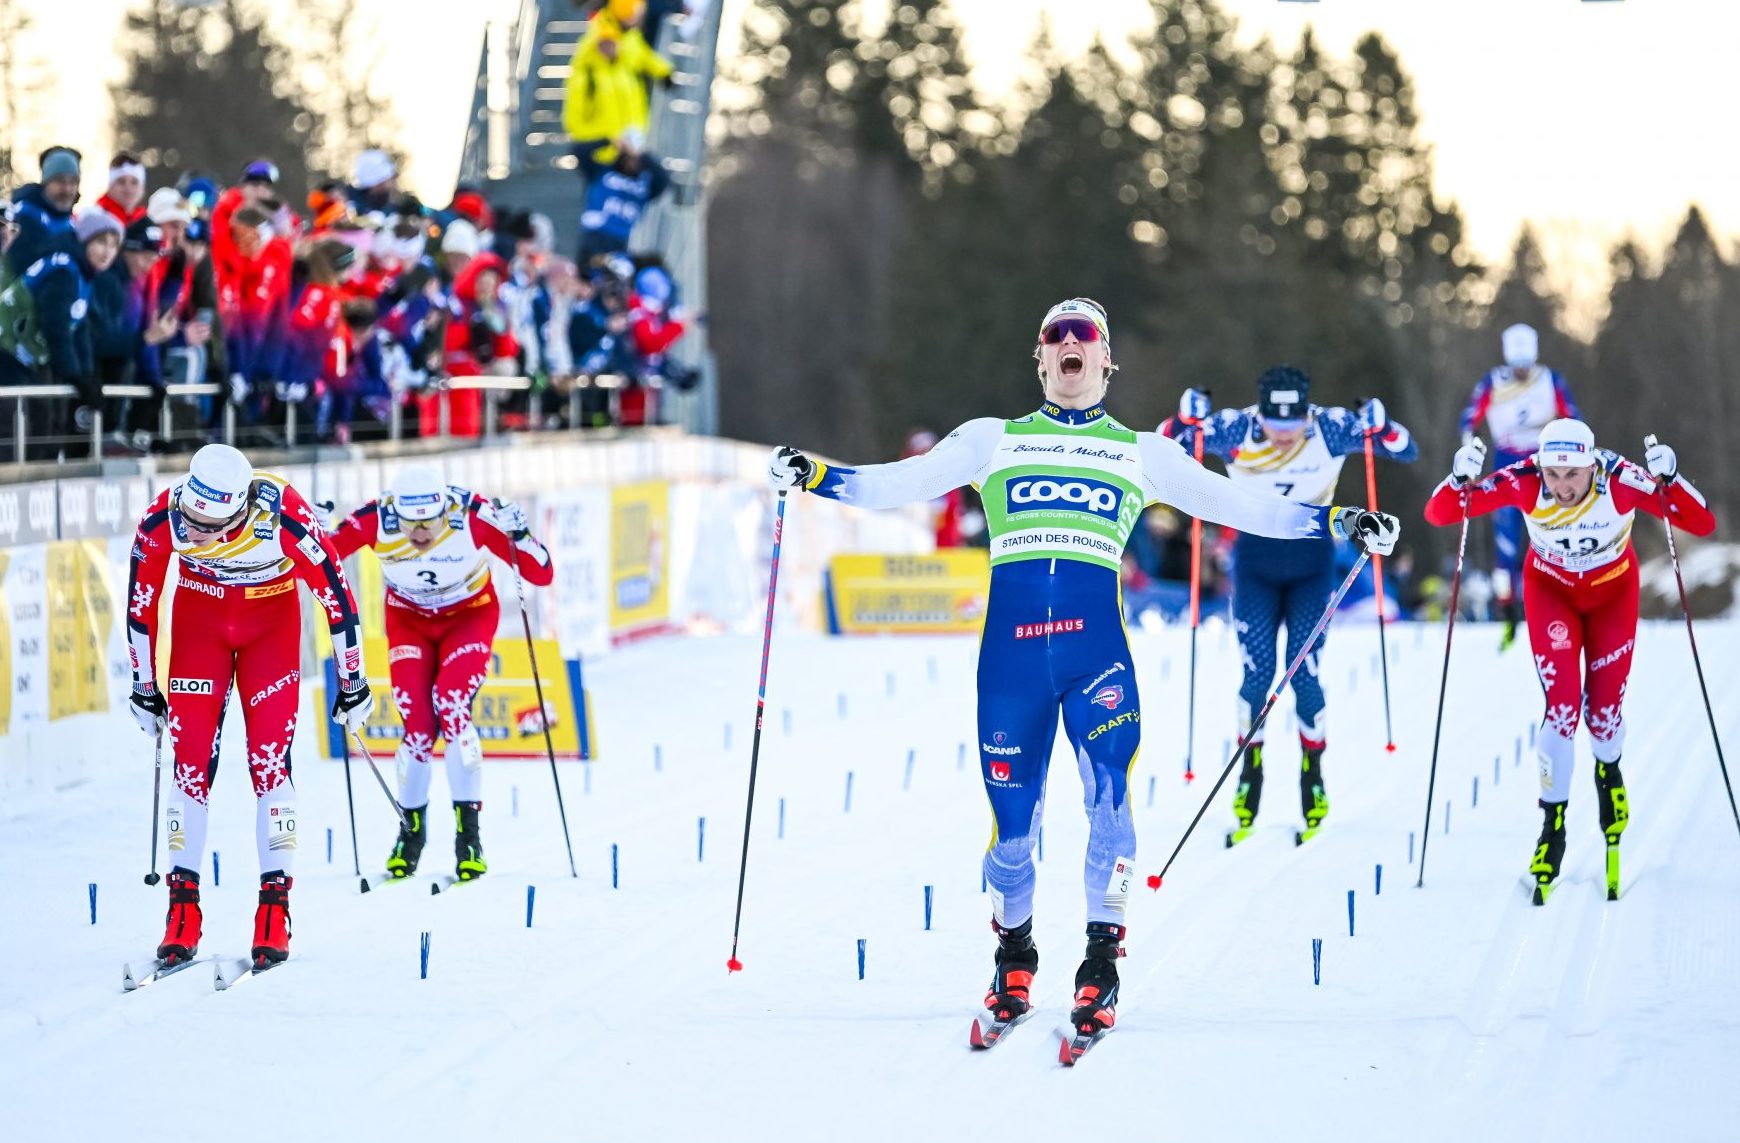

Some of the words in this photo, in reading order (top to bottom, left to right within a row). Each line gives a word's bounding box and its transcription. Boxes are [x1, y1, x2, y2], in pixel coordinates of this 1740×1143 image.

[1013, 444, 1065, 453] Biscuits
[1069, 446, 1124, 461] Mistral
[188, 479, 221, 501] SpareBank
[1011, 480, 1117, 513] coop
[1274, 483, 1295, 497] 7
[1080, 514, 1106, 526] WORLD
[1117, 491, 1142, 543] U23
[1002, 534, 1042, 548] STATION
[1045, 534, 1069, 543] DES
[1073, 536, 1118, 555] ROUSSES
[417, 570, 438, 585] 3
[253, 584, 289, 597] DHL
[1016, 619, 1084, 638] BAUHAUS
[250, 674, 291, 707] CRAFT
[1088, 712, 1132, 740] CRAFT
[983, 742, 1022, 756] SCANIA
[274, 819, 296, 832] 10
[1120, 879, 1129, 893] 5
